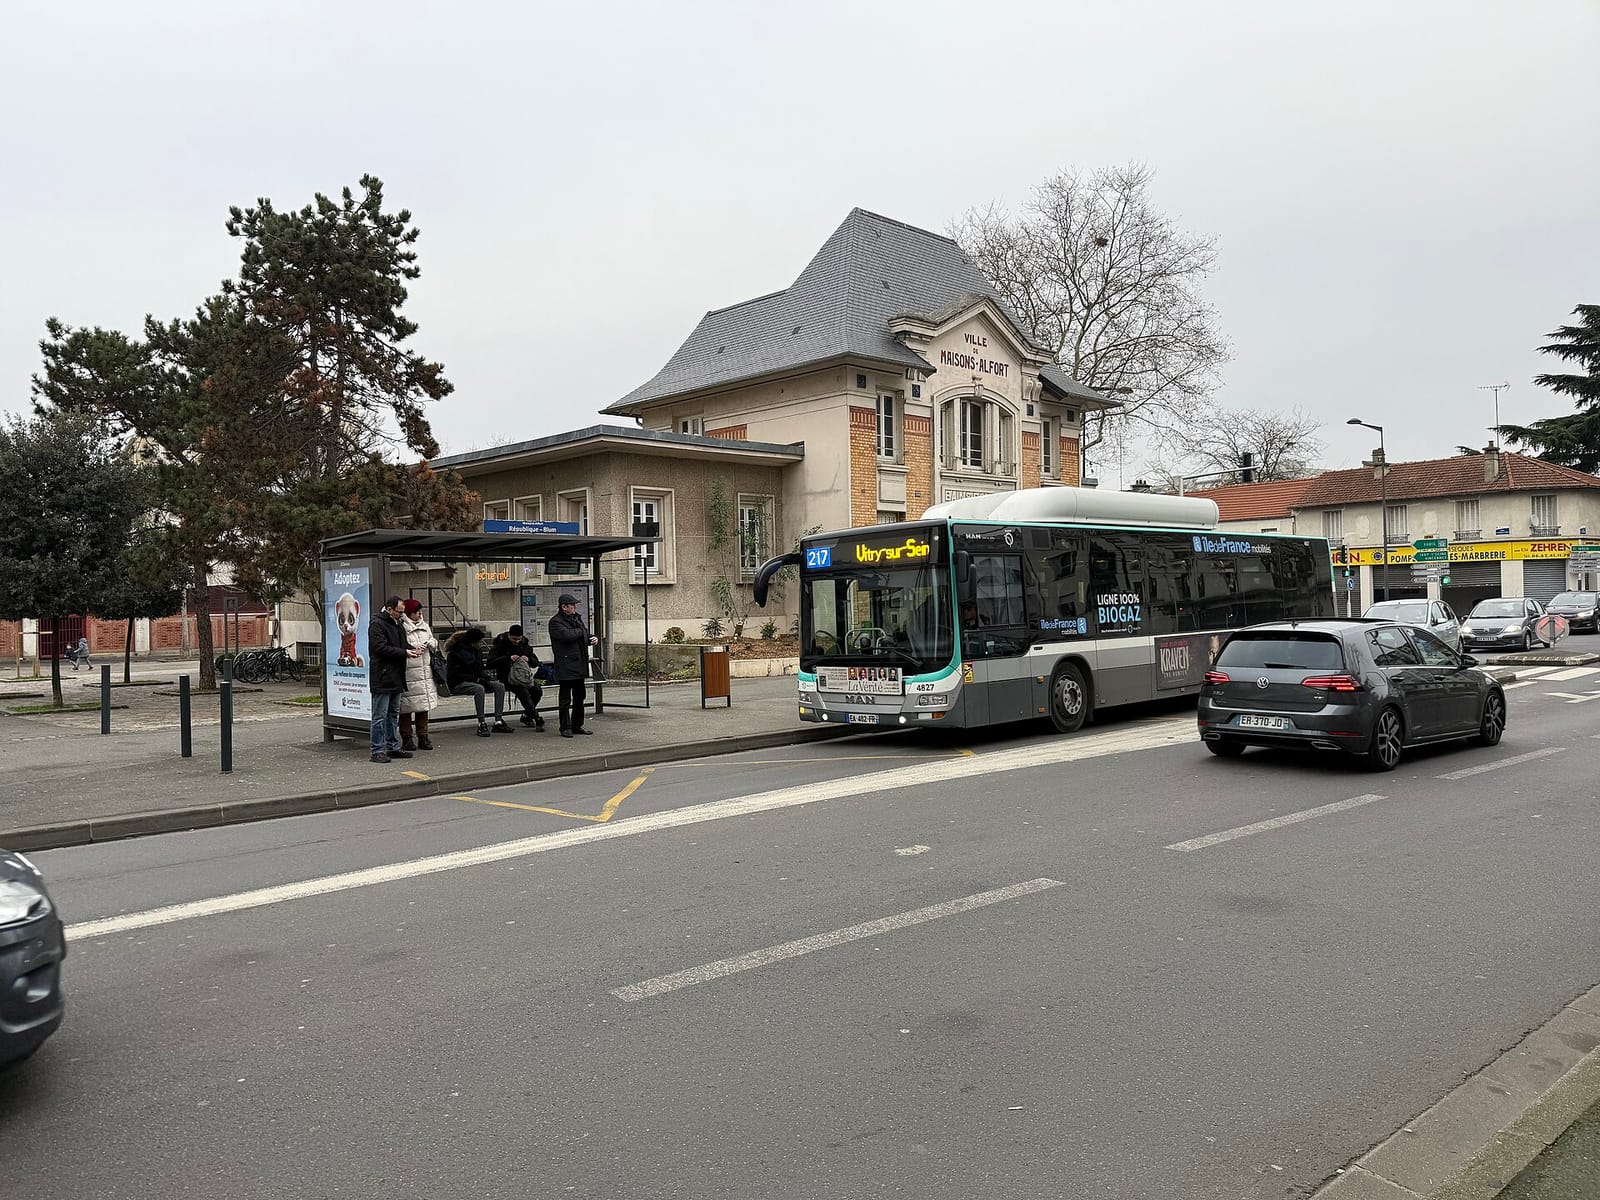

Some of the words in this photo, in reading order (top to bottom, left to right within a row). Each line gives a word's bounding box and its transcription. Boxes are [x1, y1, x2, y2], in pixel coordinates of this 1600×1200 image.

[964, 333, 988, 347] VILLE
[940, 349, 1010, 377] MAISONS-ALFORT
[508, 525, 539, 533] République
[1530, 543, 1572, 553] ZEHREN
[808, 550, 828, 566] 217
[334, 571, 361, 587] Adoptez
[1097, 594, 1118, 605] LIGNE
[1119, 593, 1140, 604] 100%
[1098, 606, 1141, 624] BIOGAZ
[1160, 646, 1189, 675] KRAVEN
[848, 681, 859, 692] La
[858, 681, 883, 693] Vérité
[916, 684, 935, 692] 4827
[845, 694, 876, 705] MAN
[1241, 715, 1283, 728] ER-370-JD
